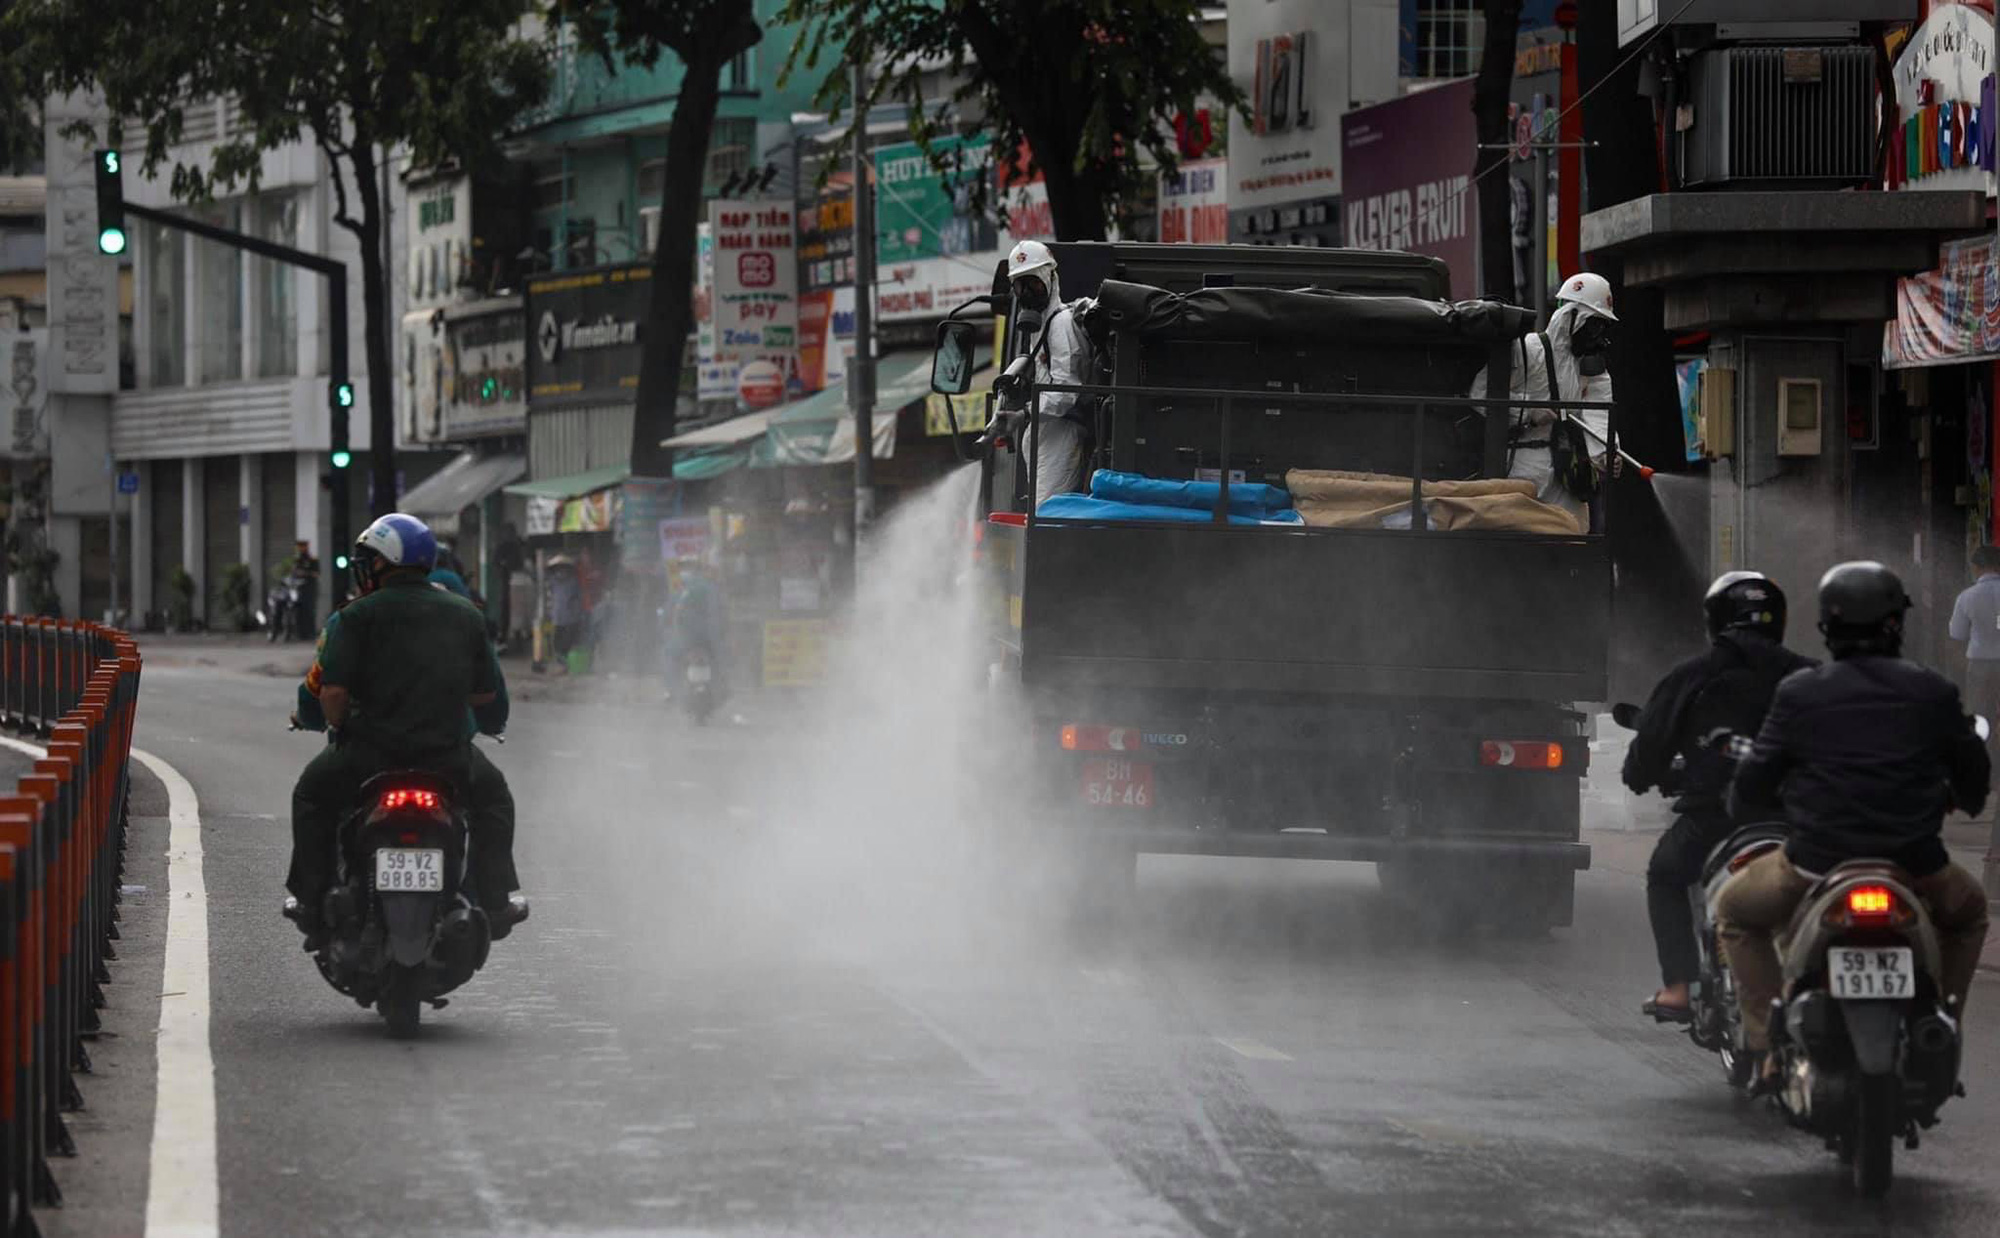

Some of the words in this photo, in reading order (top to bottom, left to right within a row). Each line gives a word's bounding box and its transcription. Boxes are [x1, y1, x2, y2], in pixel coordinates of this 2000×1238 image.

[1348, 188, 1413, 249] KLEVER
[1417, 174, 1469, 245] FRUIT
[1143, 733, 1187, 744] IVECO
[1088, 781, 1146, 805] 54-46
[387, 853, 432, 870] 59-V2
[380, 870, 438, 888] 988.85
[1843, 951, 1899, 972] 59-N2
